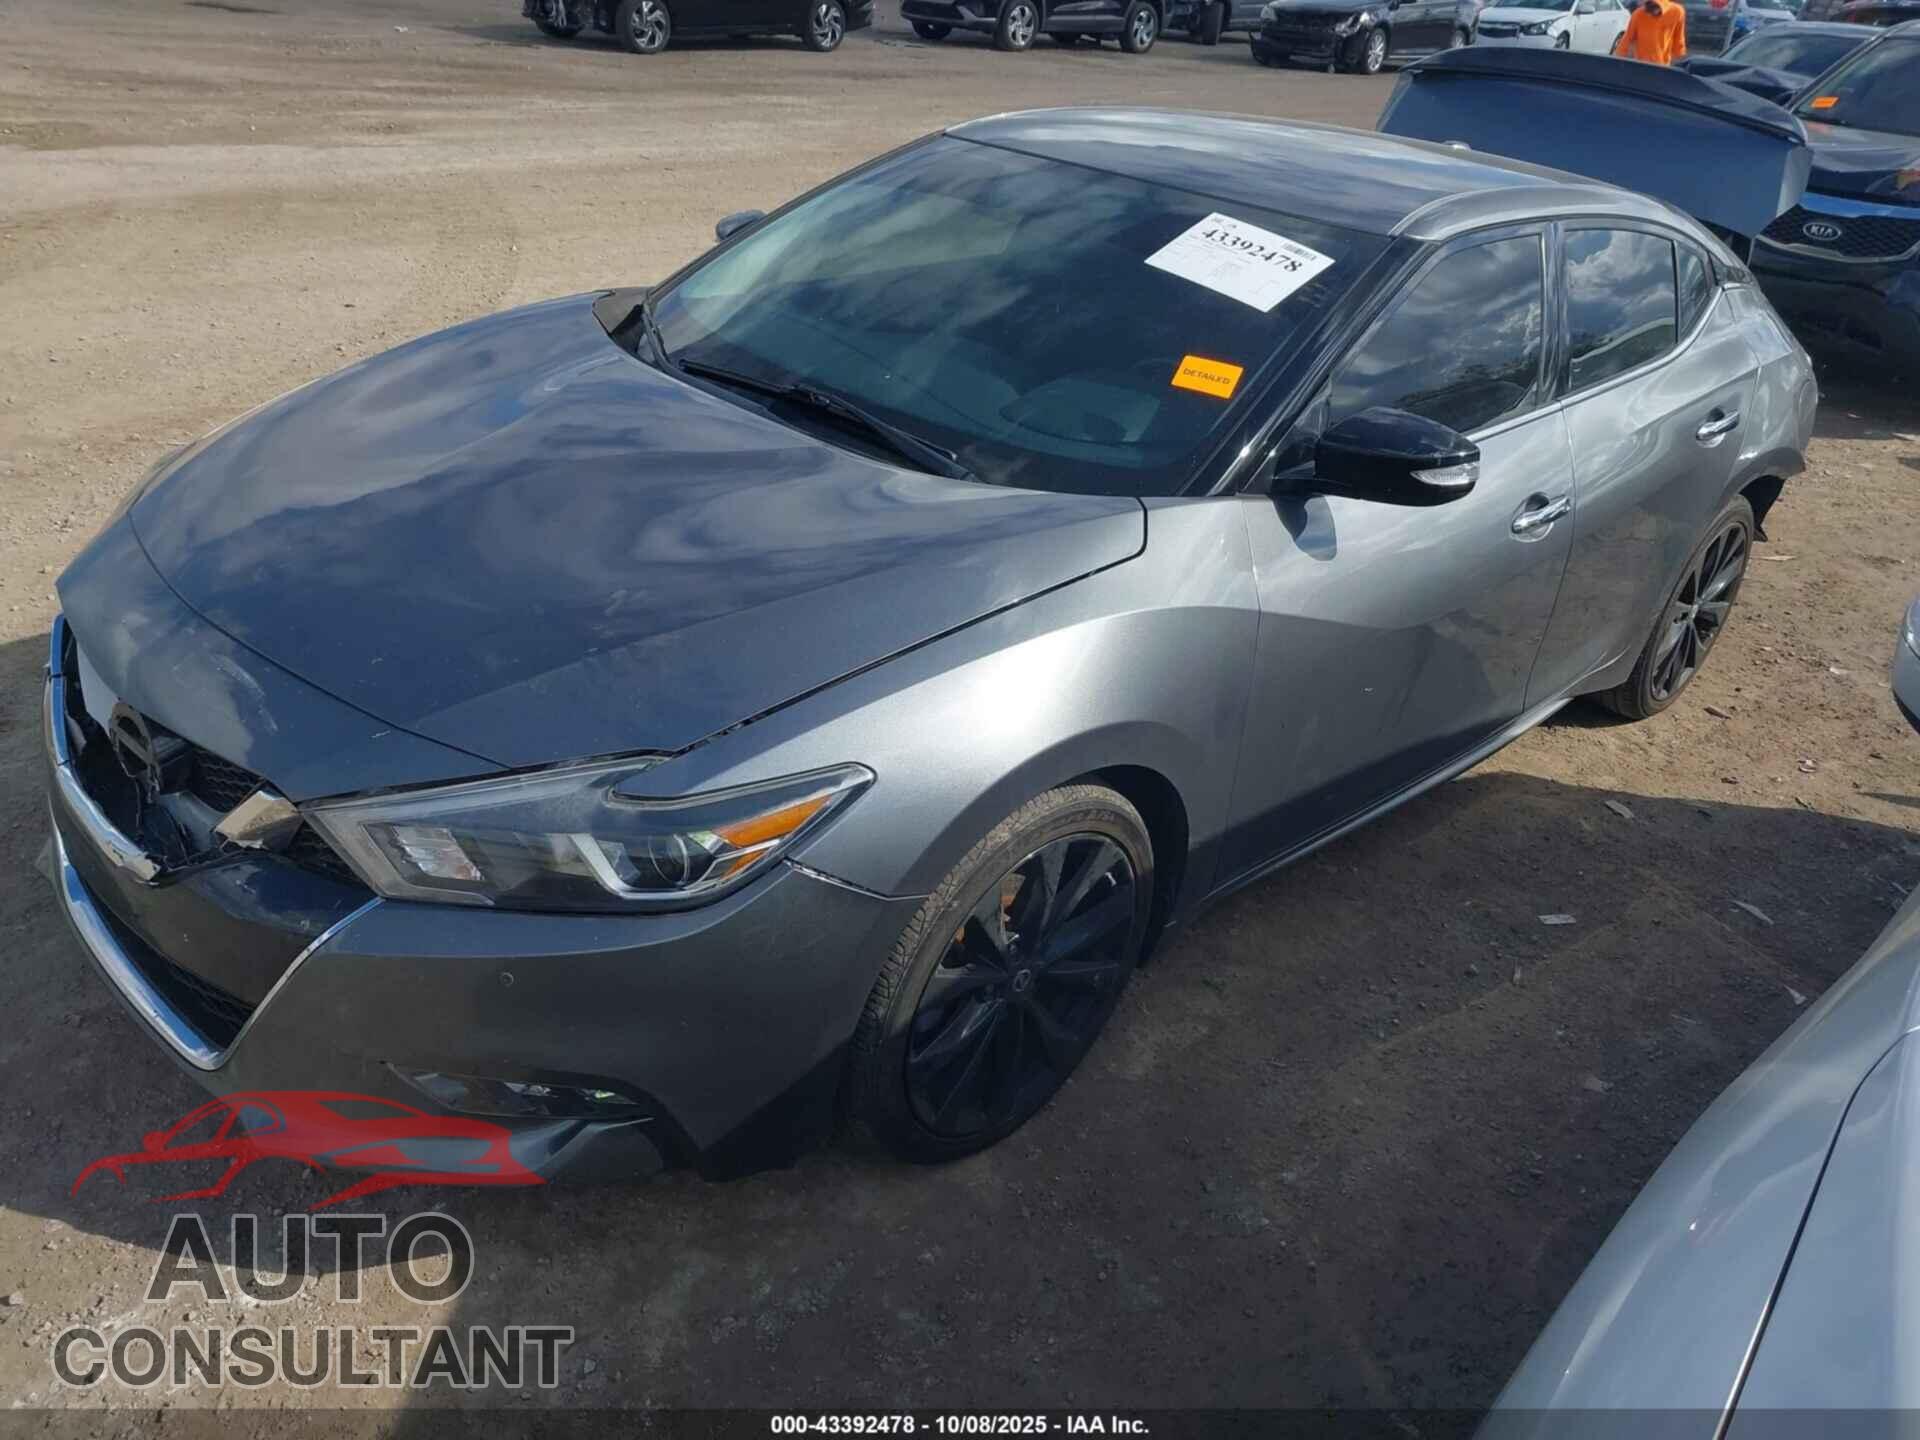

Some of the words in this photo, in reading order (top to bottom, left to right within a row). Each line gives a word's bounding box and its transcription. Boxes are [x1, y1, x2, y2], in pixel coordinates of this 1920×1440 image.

[1810, 224, 1833, 237] KIA
[1202, 229, 1303, 273] 43392478
[1183, 367, 1231, 386] DETAILED
